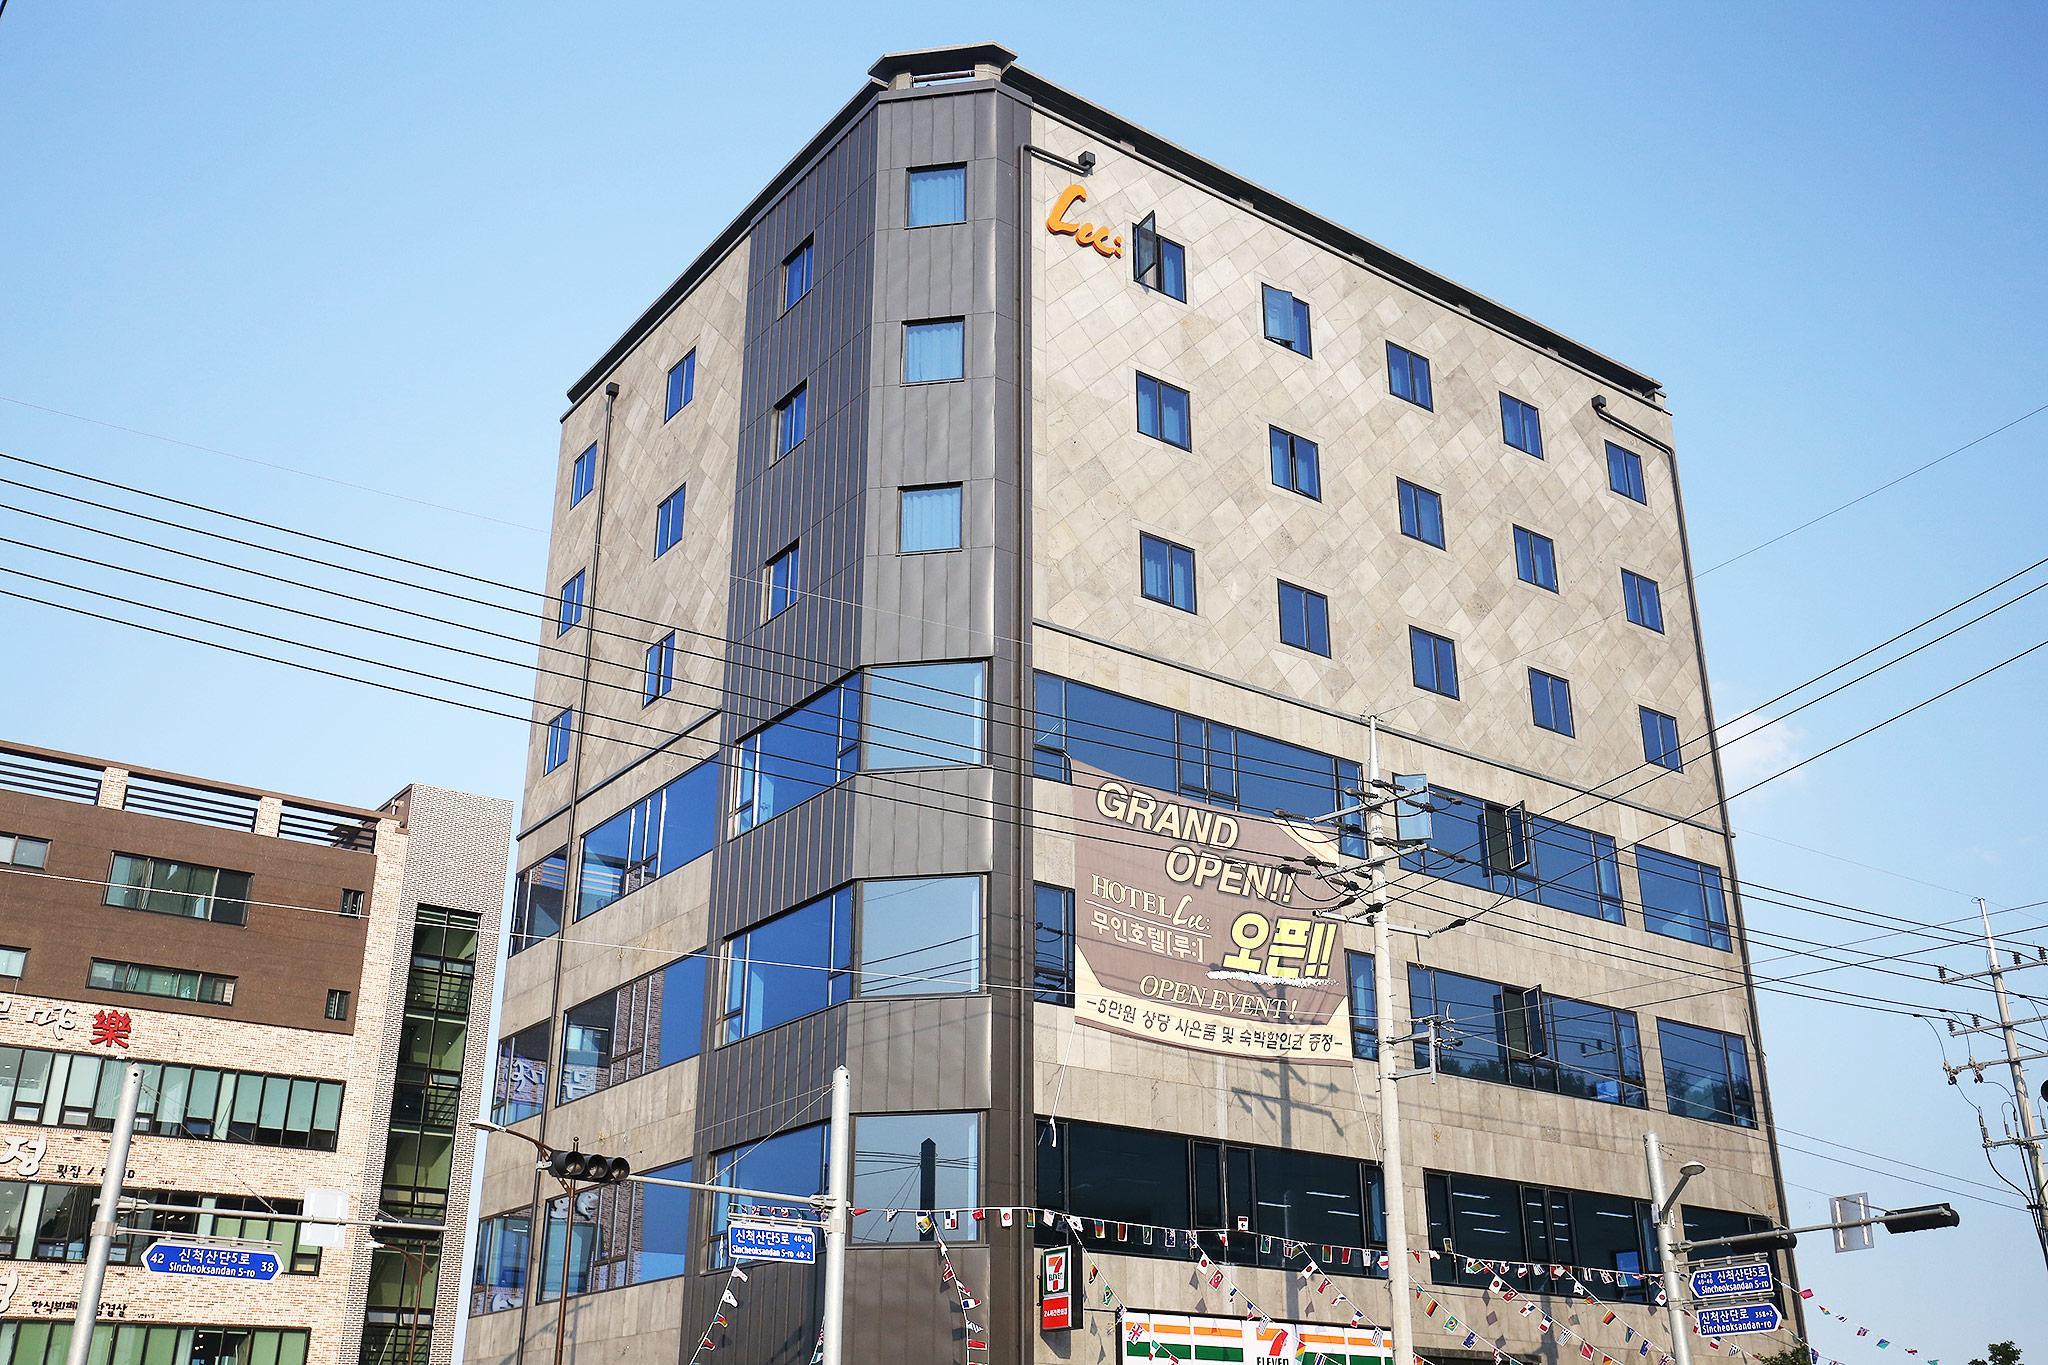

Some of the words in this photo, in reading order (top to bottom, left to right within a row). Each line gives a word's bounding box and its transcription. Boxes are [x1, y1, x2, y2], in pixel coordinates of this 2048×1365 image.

[1096, 781, 1239, 849] GRAND
[1165, 845, 1297, 903] OPEN!!
[1091, 874, 1174, 918] HOTEL
[1222, 911, 1338, 979] 오픈!!
[1140, 976, 1208, 1008] OPEN
[1210, 989, 1298, 1021] EVENT!
[89, 1009, 133, 1050] 樂
[1142, 1010, 1171, 1033] 상당
[1175, 1018, 1217, 1042] 사은품
[1222, 1026, 1234, 1046] 및
[57, 1164, 81, 1179] 횟집
[736, 1229, 790, 1245] 신척산단5로
[794, 1235, 812, 1244] 40-40
[150, 1252, 165, 1264] 42
[179, 1248, 250, 1265] 신척산단5로
[732, 1244, 780, 1257] Sincheoksandan
[781, 1249, 794, 1258] 5-ro
[169, 1262, 236, 1277] Sincheoksandan
[238, 1267, 255, 1278] 5-ro
[260, 1261, 275, 1273] 38
[1048, 1255, 1063, 1290] 7
[1717, 1266, 1767, 1284] 신척산단5로
[1702, 1281, 1754, 1294] Sincheoksandan
[1755, 1280, 1769, 1289] 5-ro
[1702, 1308, 1749, 1325] 신척산단로
[1702, 1321, 1772, 1334] Sincheoksandan-ro
[1256, 1328, 1288, 1357] 7
